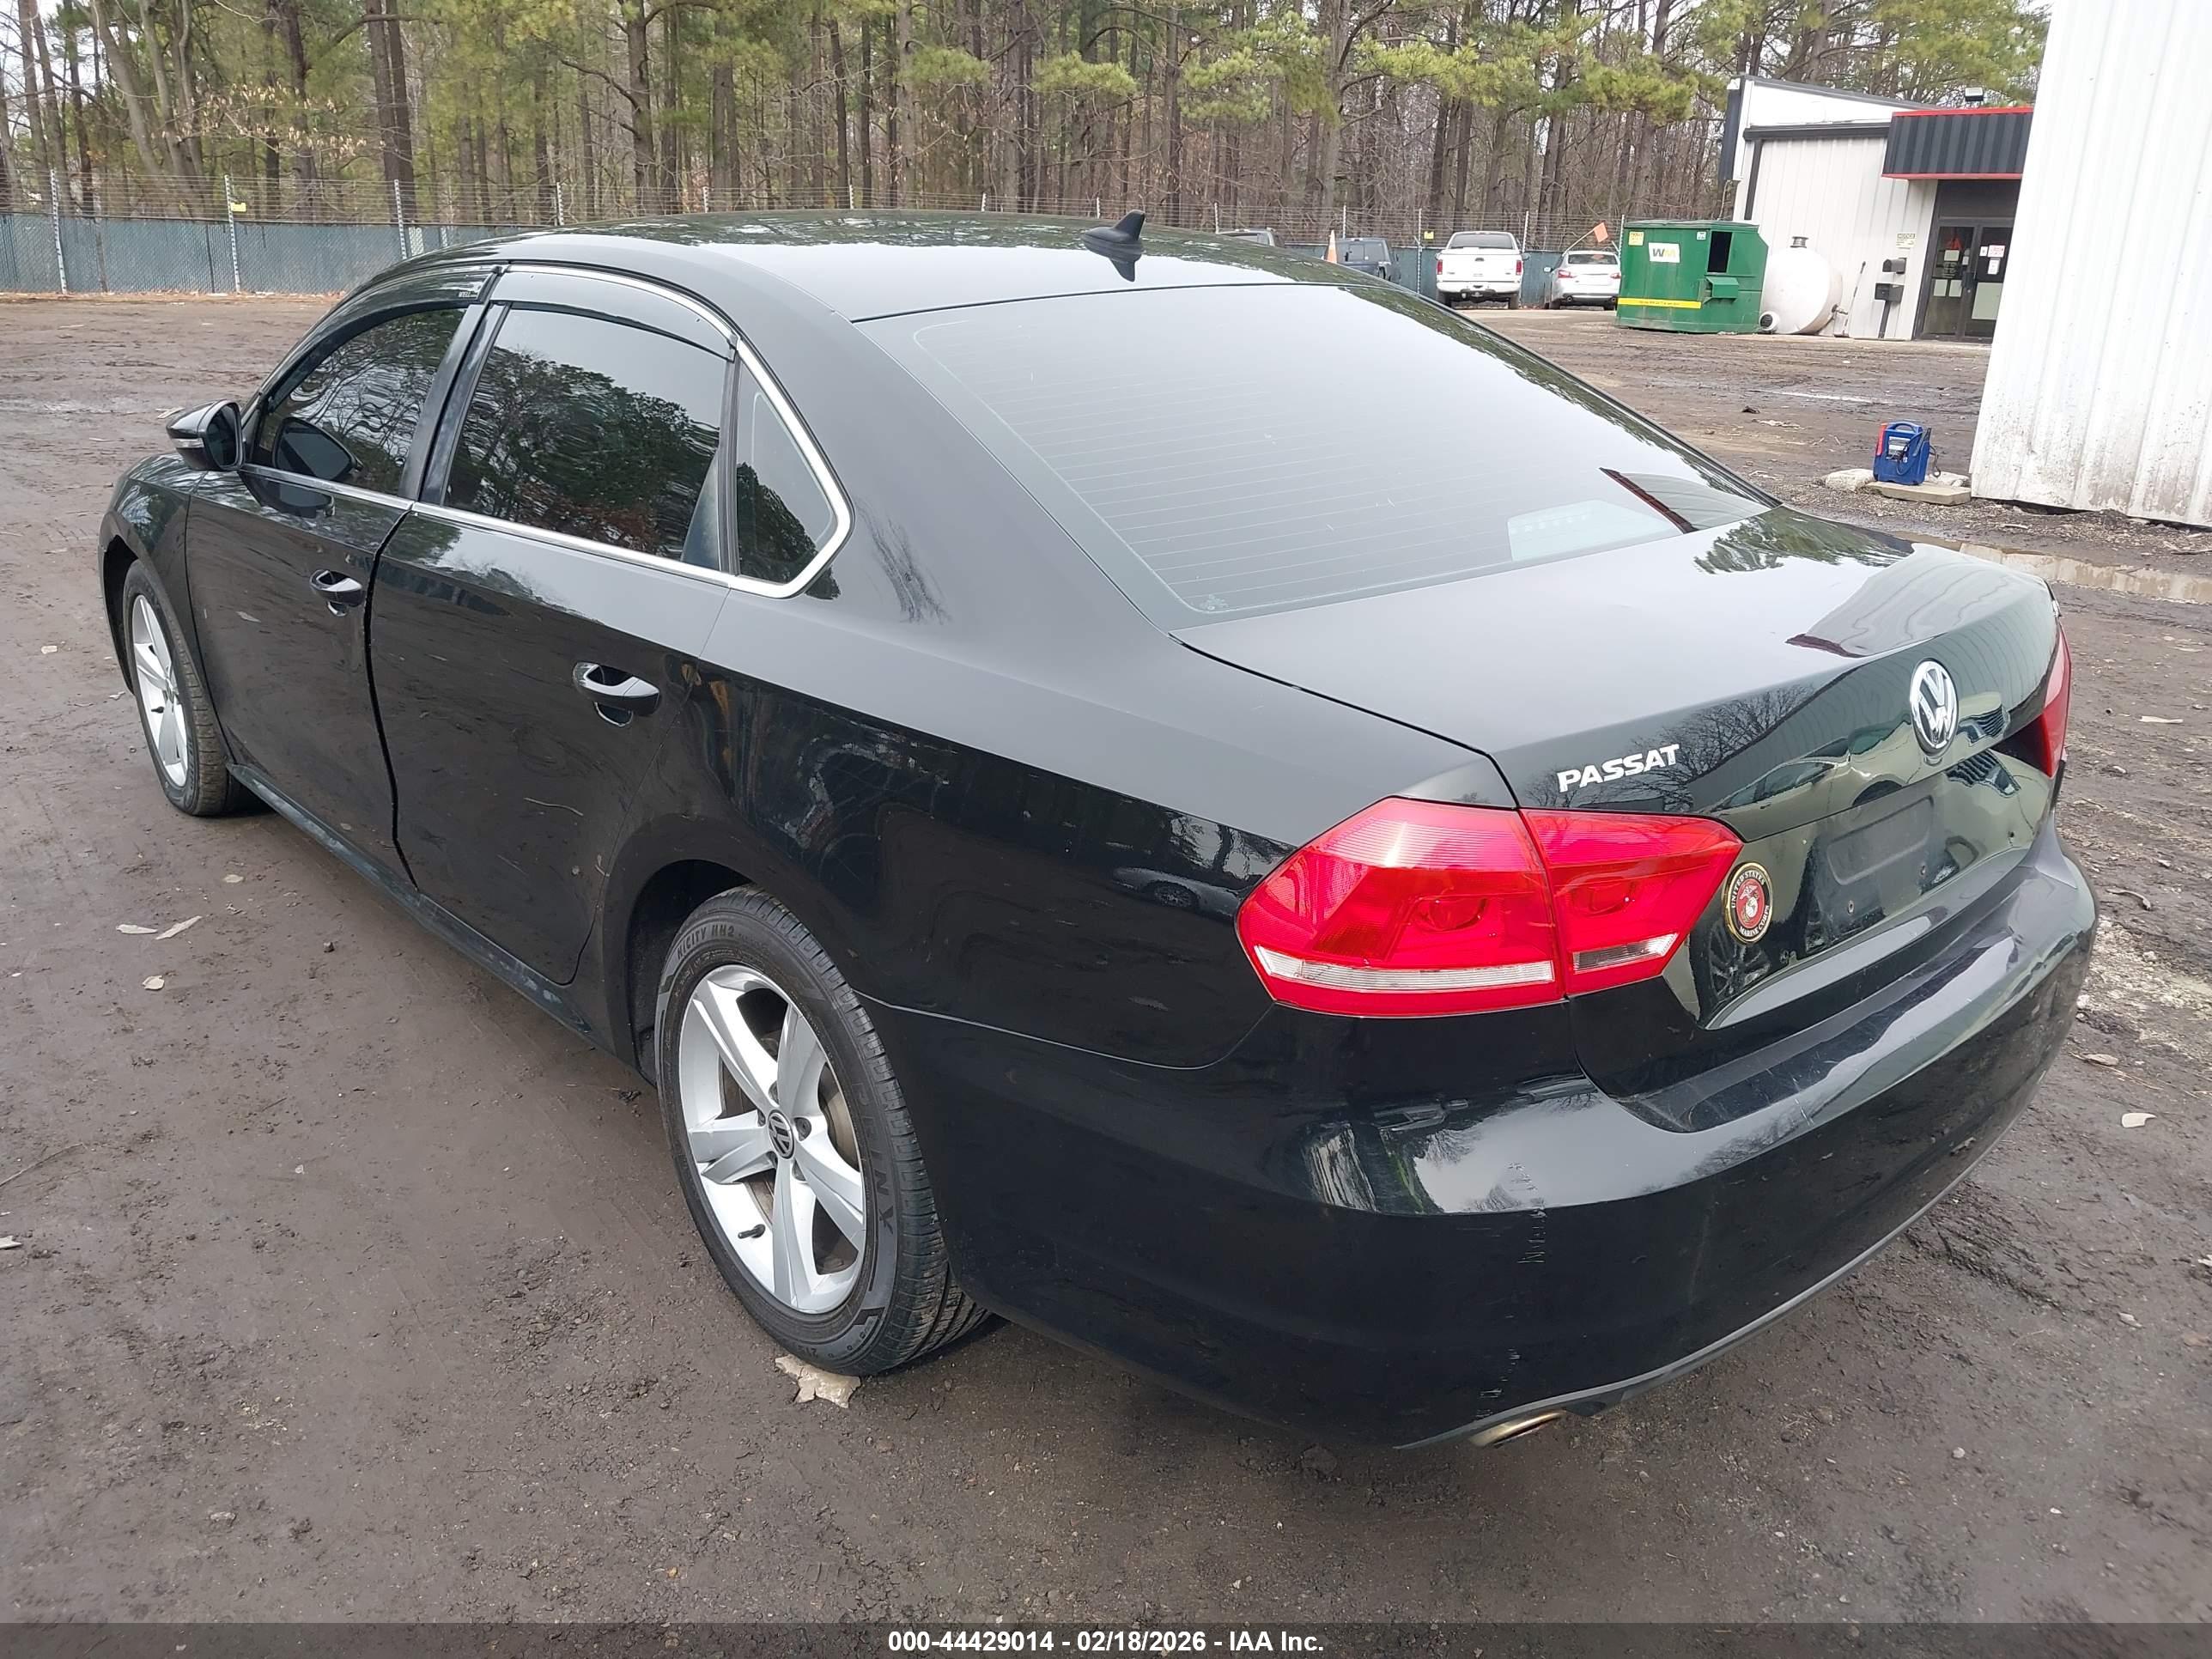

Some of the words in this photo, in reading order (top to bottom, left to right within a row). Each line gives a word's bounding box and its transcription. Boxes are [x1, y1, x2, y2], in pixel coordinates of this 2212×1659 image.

[1556, 744, 1680, 793] PASSAT
[1731, 874, 1745, 908] UNITED
[1744, 870, 1765, 885] STATES
[1739, 926, 1759, 937] MARINE
[1758, 904, 1770, 930] CORPS
